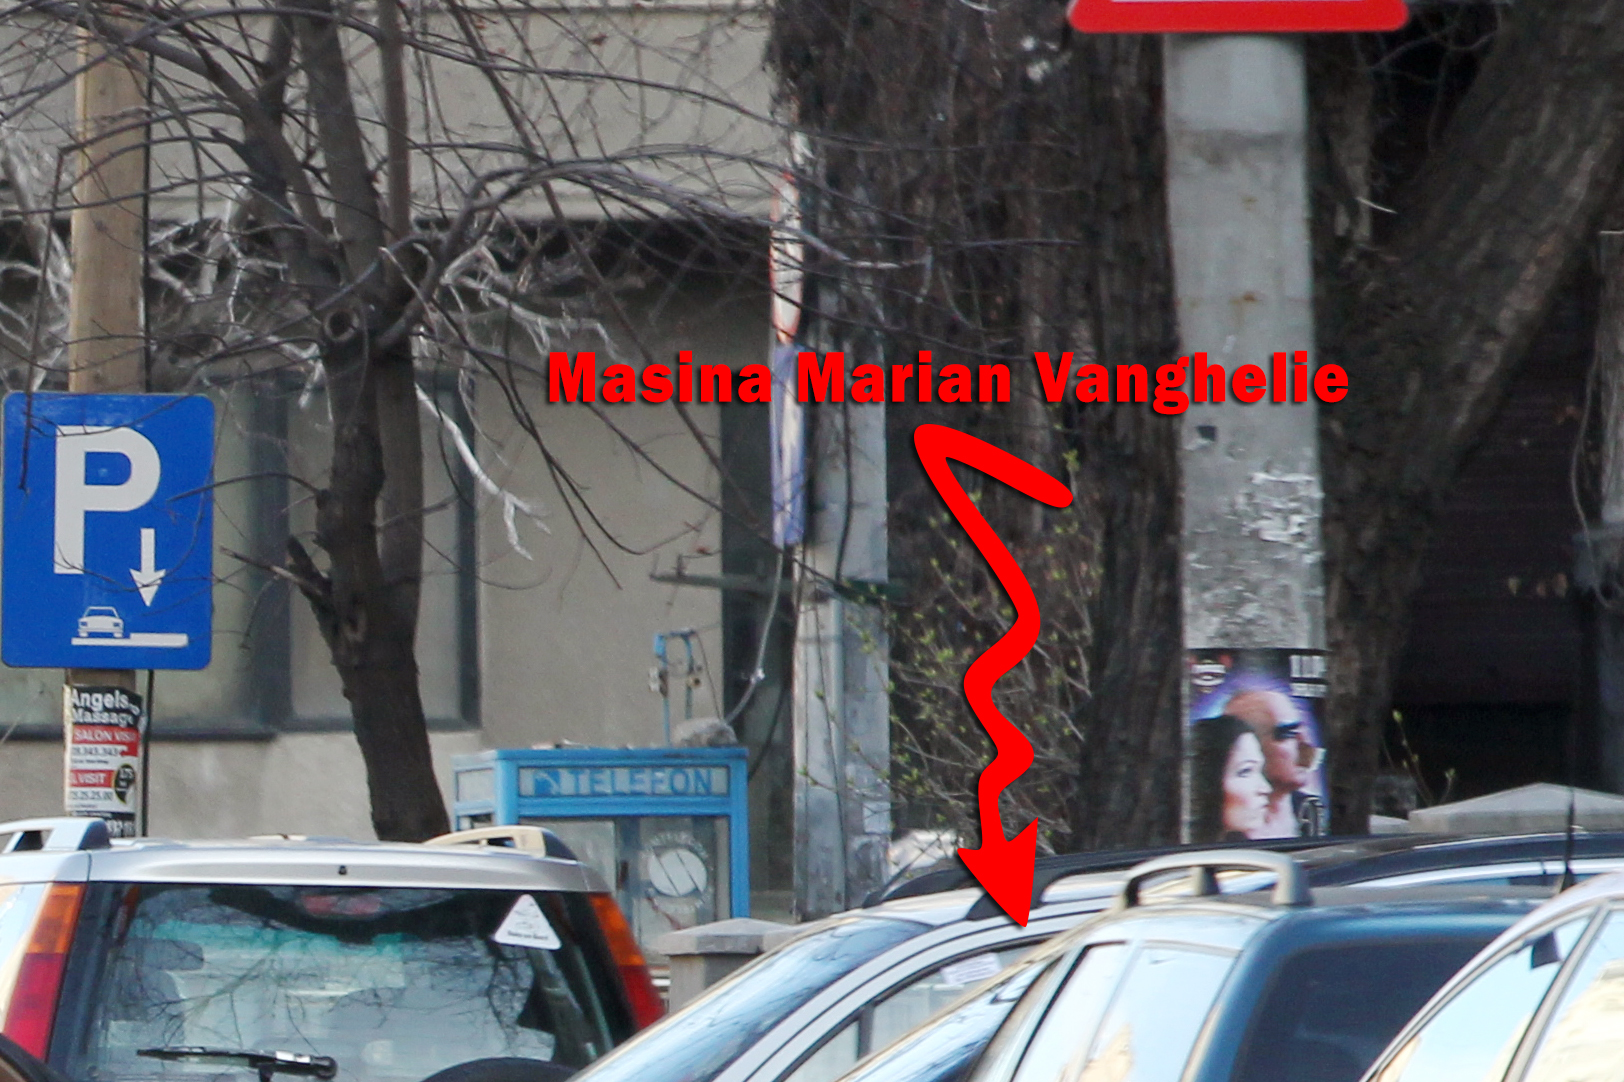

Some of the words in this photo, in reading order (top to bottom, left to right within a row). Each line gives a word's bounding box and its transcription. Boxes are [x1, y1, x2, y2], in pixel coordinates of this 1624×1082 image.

[54, 425, 161, 575] P
[72, 689, 129, 711] Angels
[75, 729, 113, 741] SALON
[567, 768, 712, 796] TELEFON
